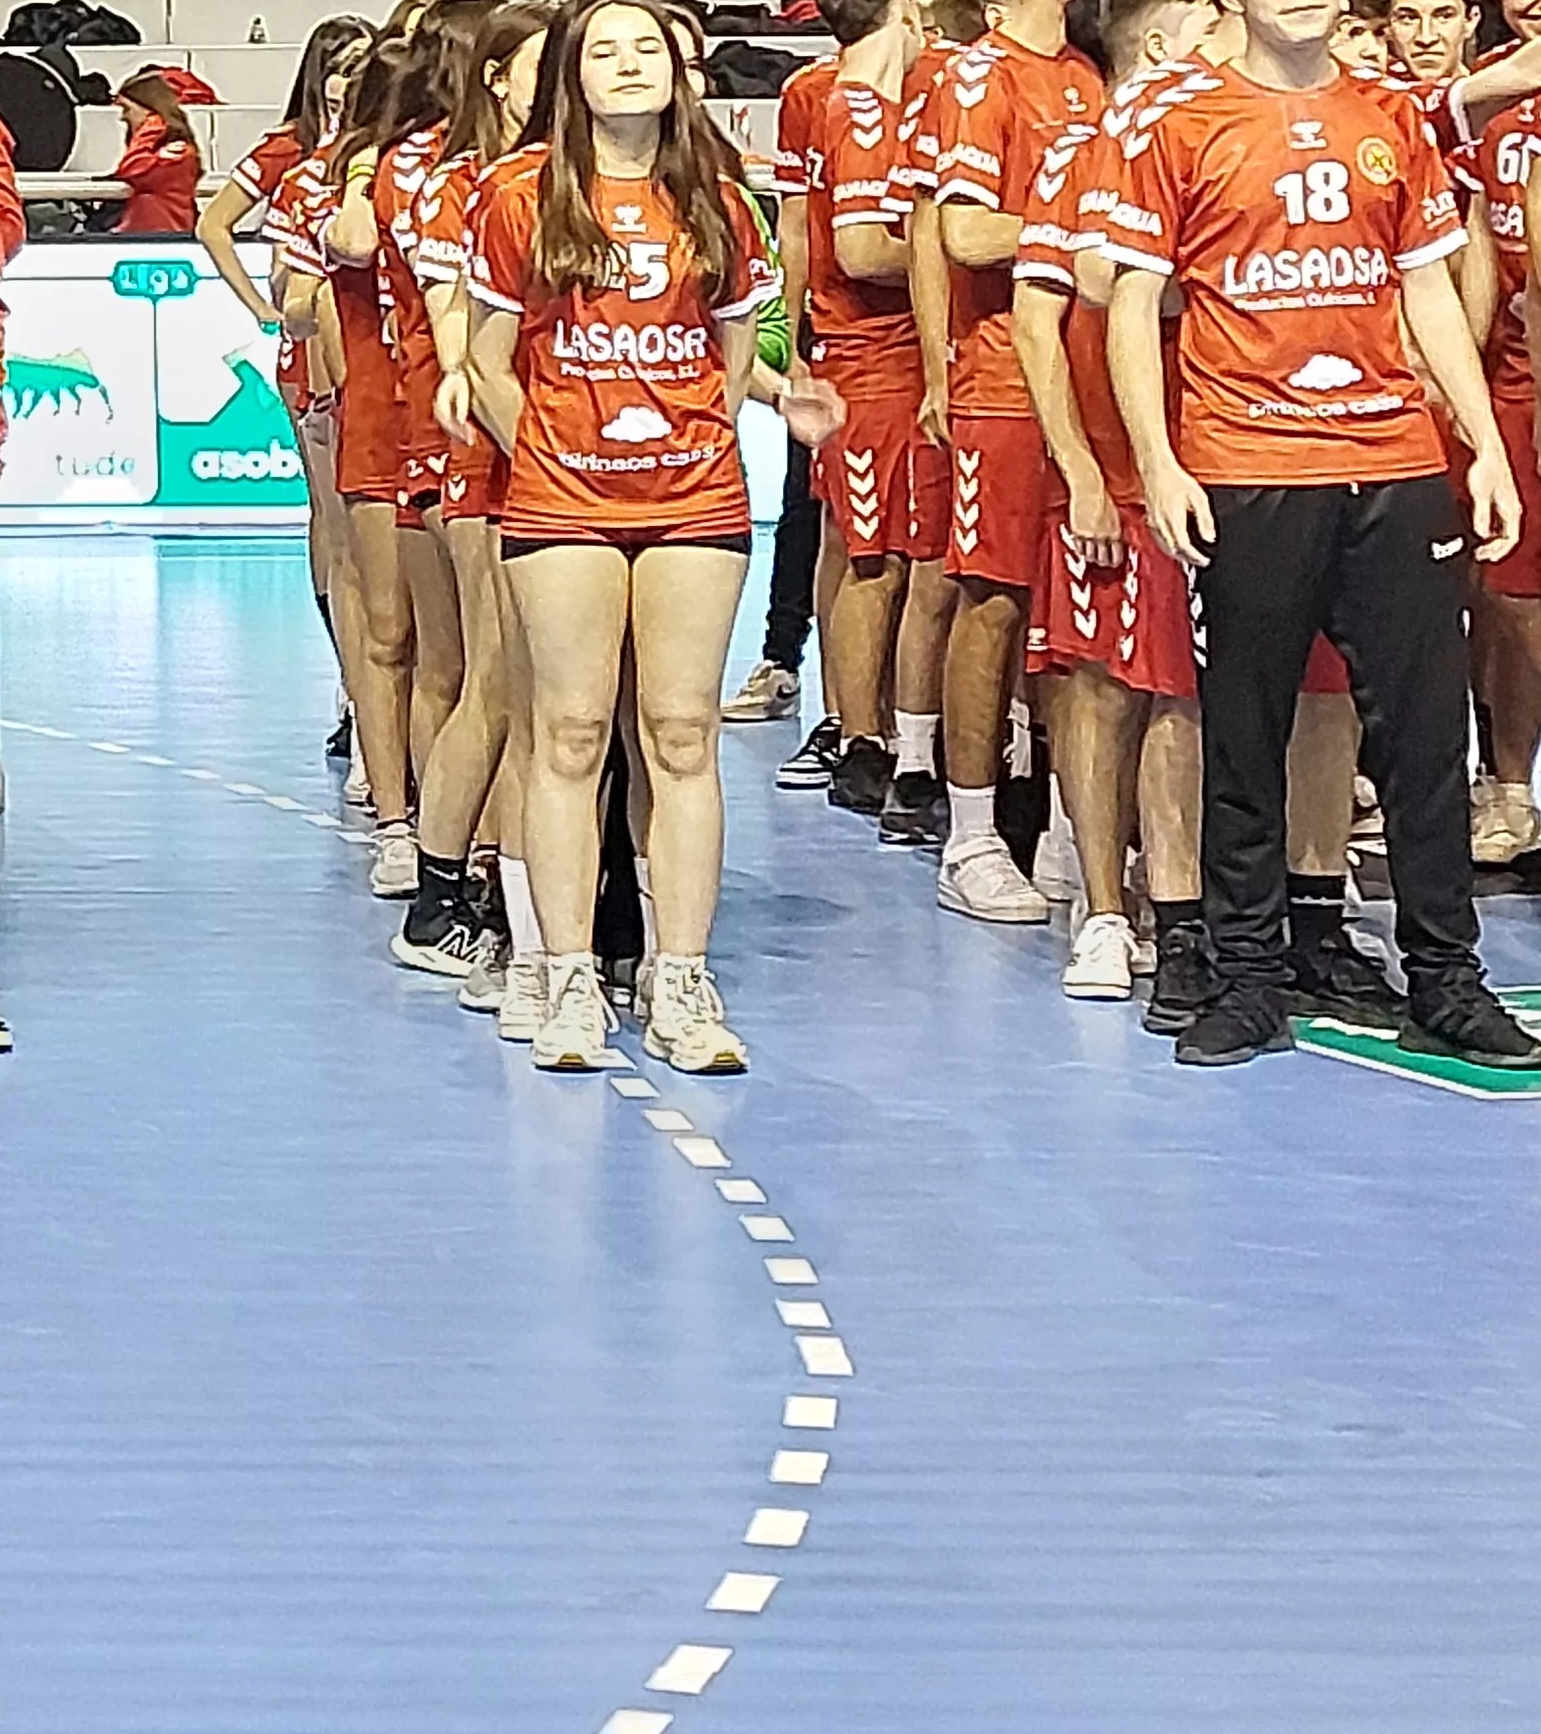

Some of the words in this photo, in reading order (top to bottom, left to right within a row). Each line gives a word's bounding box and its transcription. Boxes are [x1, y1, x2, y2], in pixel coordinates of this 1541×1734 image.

[1273, 159, 1351, 225] 18
[1223, 245, 1390, 298] LASAOSA
[553, 319, 709, 364] LASAOSA
[190, 438, 306, 480] asob
